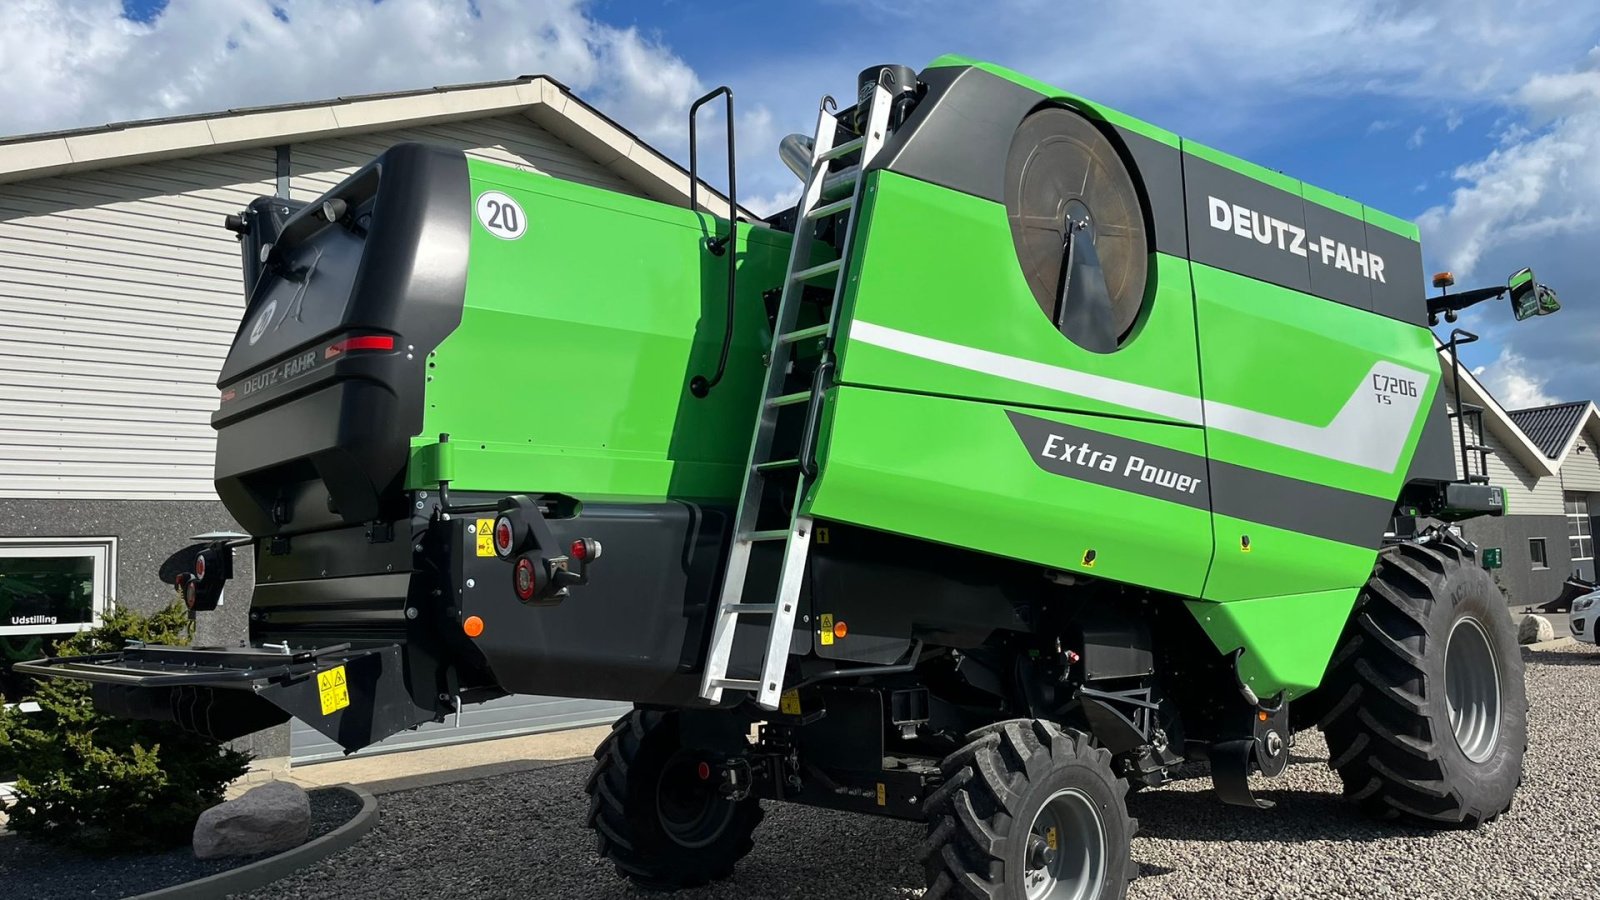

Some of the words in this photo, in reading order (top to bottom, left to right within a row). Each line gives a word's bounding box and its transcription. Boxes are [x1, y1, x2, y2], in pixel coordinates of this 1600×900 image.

[487, 200, 518, 232] 20
[1208, 195, 1386, 284] DEUTZ-FAHR
[243, 351, 316, 395] DEUTZ-FAHR
[1373, 373, 1417, 398] C7206
[1375, 393, 1392, 405] TS
[1041, 433, 1118, 473] Extra
[1123, 455, 1202, 495] Power
[11, 614, 58, 625] Udstilling
